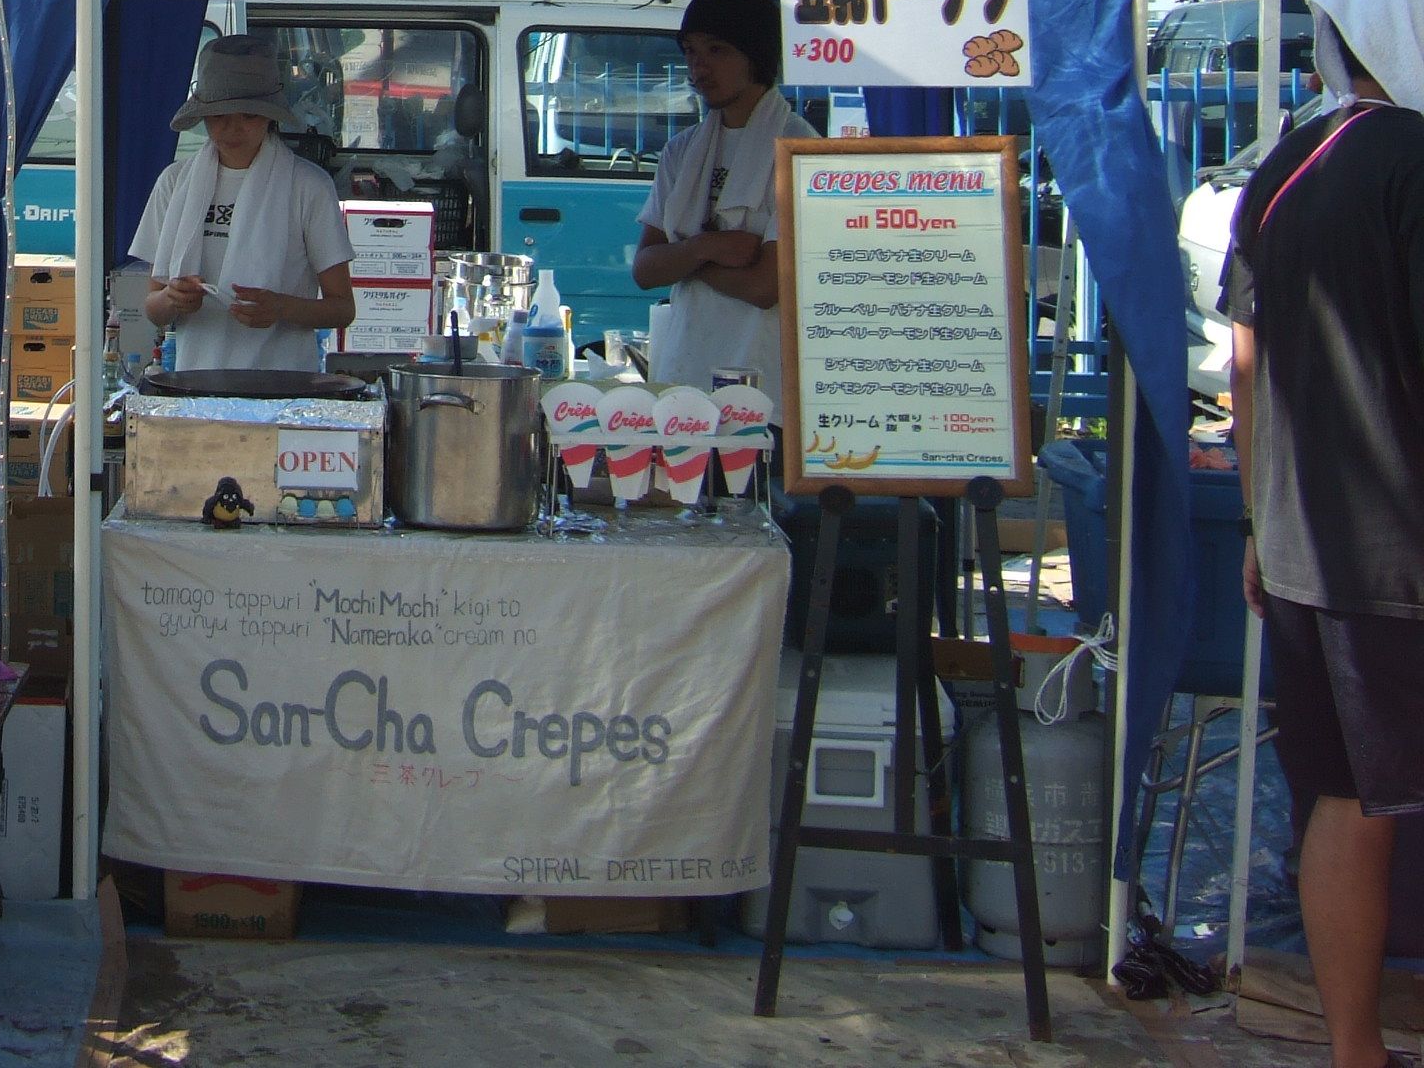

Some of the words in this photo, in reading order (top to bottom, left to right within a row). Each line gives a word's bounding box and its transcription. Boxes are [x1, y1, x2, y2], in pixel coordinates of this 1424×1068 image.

[792, 37, 855, 64] ¥300
[810, 170, 901, 195] crepes
[906, 170, 985, 192] menu
[845, 215, 869, 229] all
[828, 249, 976, 262] チョコバナナ生クリーム
[818, 272, 988, 285] チョコアーモンド生クリーム
[814, 302, 994, 318] ブルーベリーバナナ生クリーム
[806, 325, 1003, 341] ブルーベリーアーモンド生クリーム
[825, 358, 985, 373] シナモンバナナ生クリーム
[815, 381, 996, 396] シナモンアーモンド生クリーム
[664, 416, 711, 436] Crêpe
[818, 413, 880, 429] 生クリーム
[278, 449, 358, 474] OPEN
[966, 453, 1004, 463] Crepes
[141, 581, 215, 617] tamago
[224, 587, 301, 621] tappuri
[498, 595, 521, 618] to
[158, 611, 229, 638] gyunyu
[239, 616, 311, 645] tappuri
[443, 626, 505, 647] cream
[513, 627, 537, 647] no
[200, 658, 437, 752] San-Cha
[461, 678, 672, 787] Crepes
[503, 855, 591, 883] SPIRAL
[607, 856, 714, 882] DRIFTER
